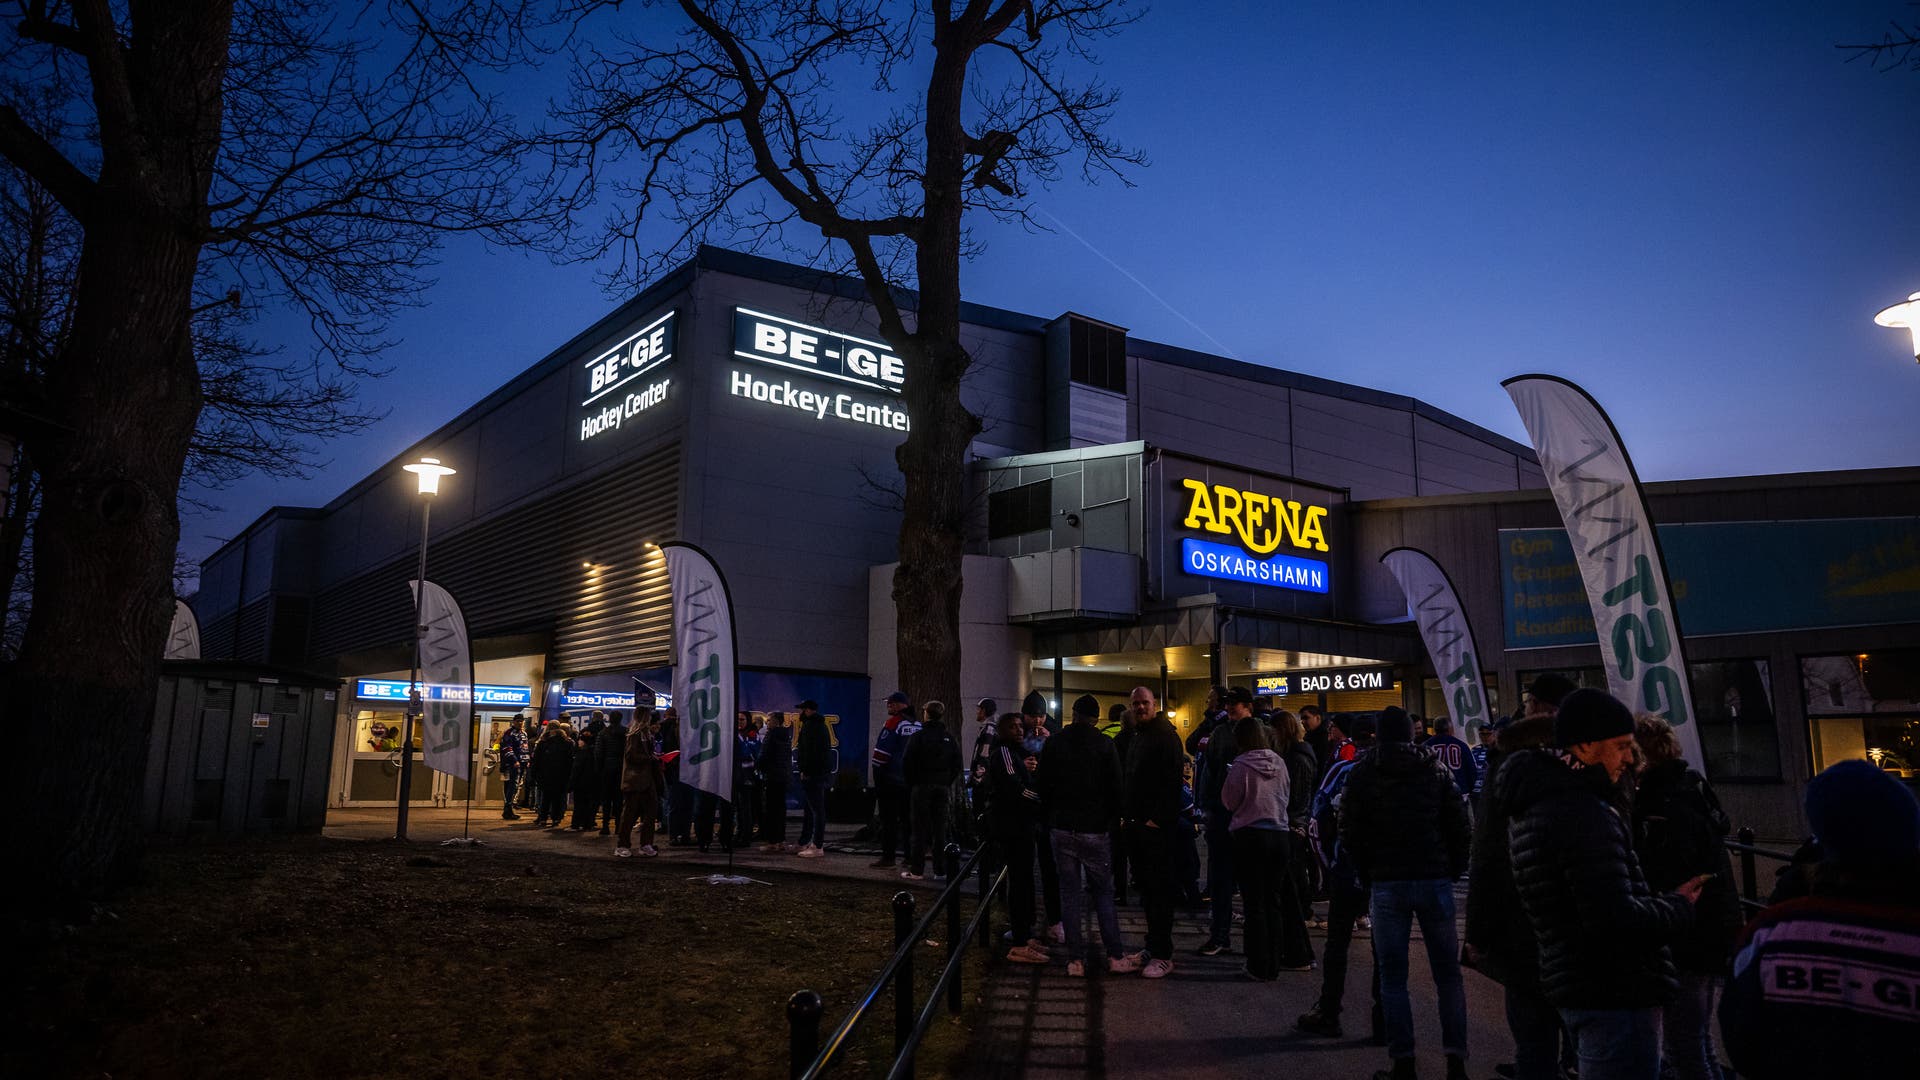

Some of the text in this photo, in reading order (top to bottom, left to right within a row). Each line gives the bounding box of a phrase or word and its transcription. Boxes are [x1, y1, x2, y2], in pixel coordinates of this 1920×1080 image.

[590, 327, 666, 393] BE-GE
[754, 322, 905, 384] BE-GE
[580, 378, 670, 441] Hockey Center
[731, 371, 830, 419] Hockey
[1182, 478, 1330, 554] ARENA
[1510, 538, 1553, 558] Gym
[1191, 550, 1322, 589] OSKARSHAMN
[486, 690, 525, 701] Center
[1301, 672, 1382, 691] BAD & GYM
[1432, 744, 1462, 770] 70
[1775, 966, 1920, 1008] BE-G
